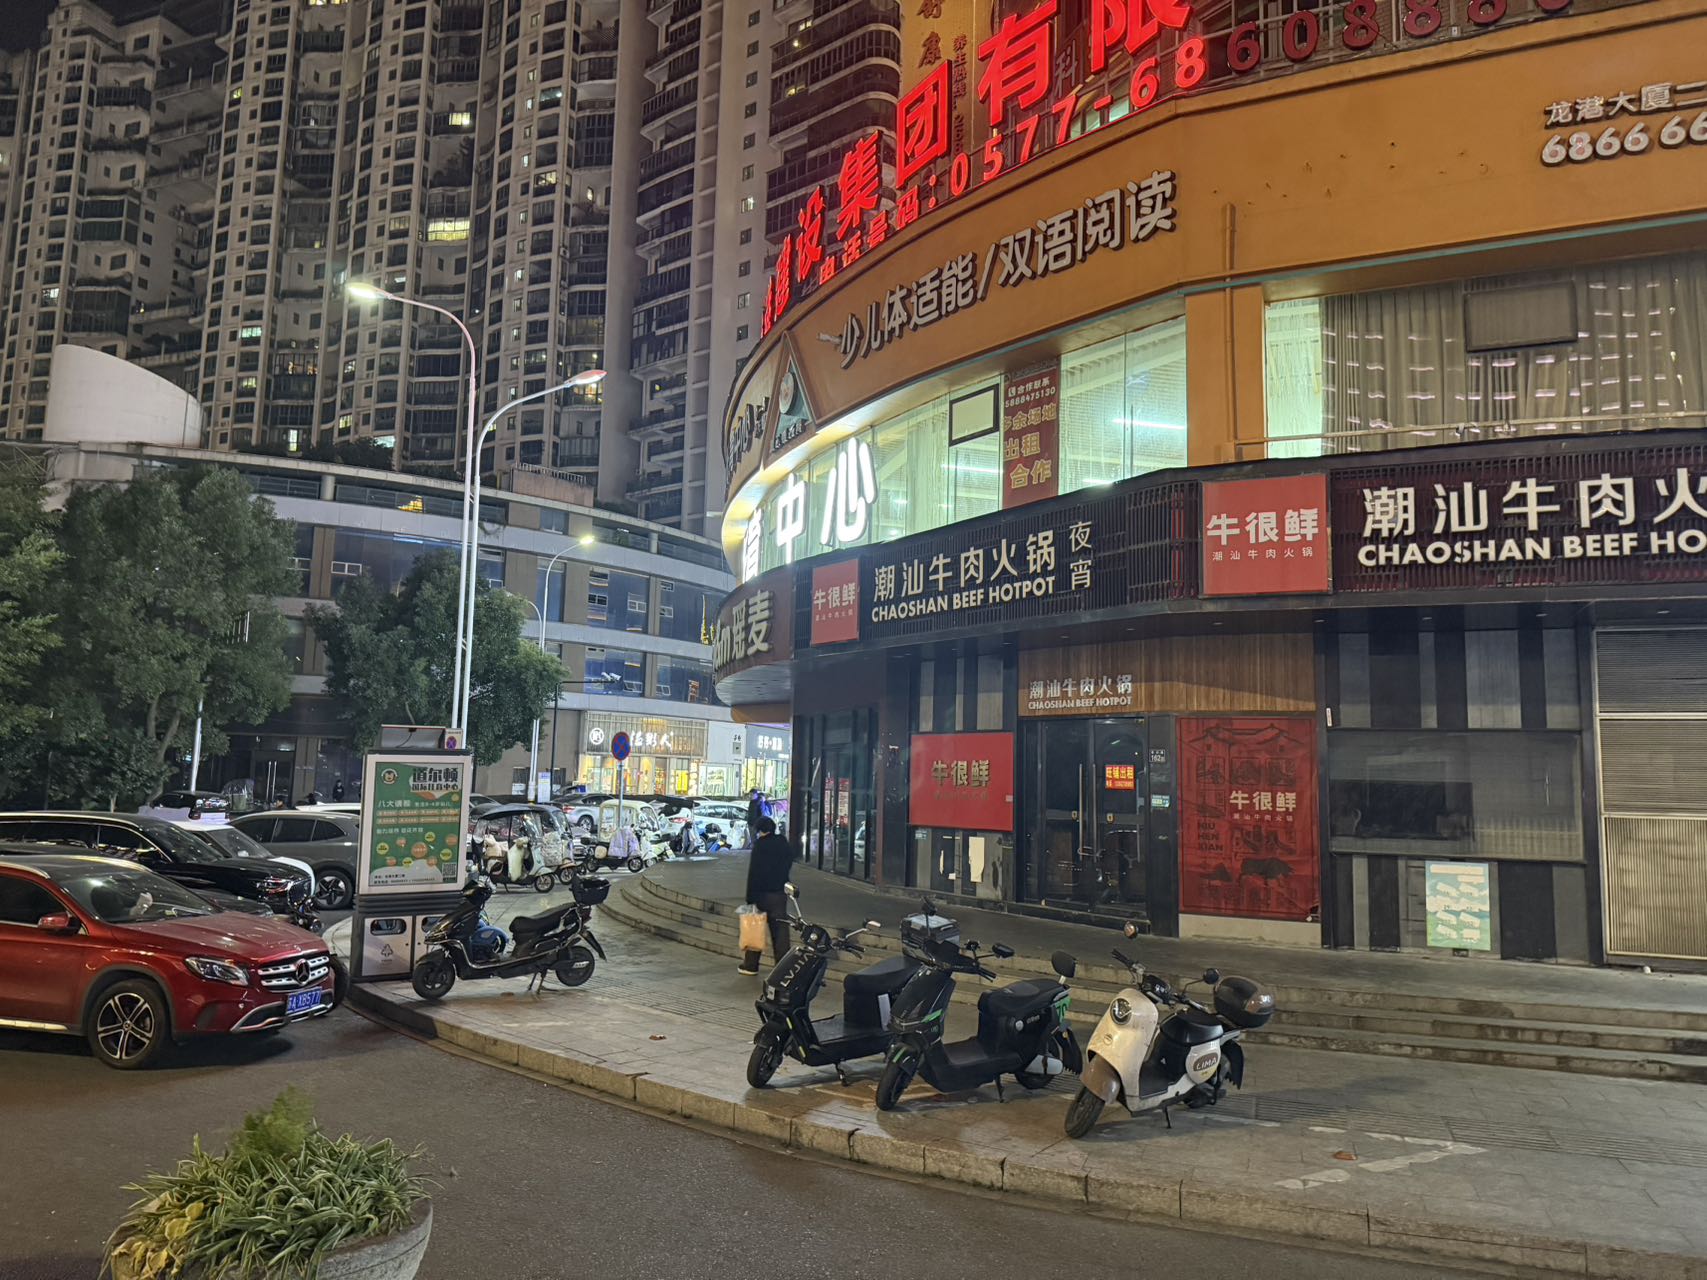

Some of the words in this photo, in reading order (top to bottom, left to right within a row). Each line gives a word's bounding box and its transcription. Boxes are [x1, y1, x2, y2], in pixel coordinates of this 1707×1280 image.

[1542, 122, 1650, 165] 6866
[840, 170, 1175, 369] 少儿体适能/双语阅读
[1003, 402, 1057, 432] 多余场地
[1004, 431, 1041, 461] 出租
[1010, 458, 1052, 489] 合作
[1362, 467, 1707, 538] 潮汕牛肉火
[1206, 507, 1319, 545] 牛很鲜
[1069, 520, 1093, 591] 夜宵
[1212, 546, 1313, 561] 潮汕牛肉火锅
[1357, 537, 1551, 567] CHAOSHAN
[1563, 532, 1640, 559] BEEF
[873, 529, 1056, 602] 潮汕牛肉火锅
[813, 582, 857, 611] 牛很鲜
[872, 595, 948, 623] CHAOSHAN
[952, 588, 985, 611] BEEF
[989, 576, 1056, 604] HOTPOT
[1029, 674, 1133, 699] 潮汕牛肉火锅
[1028, 700, 1075, 710] CHAOSHAN
[1076, 698, 1096, 707] BEEF
[1096, 696, 1133, 707] HOTPOT
[932, 759, 991, 787] 牛很鲜
[1229, 790, 1297, 812] 牛很鲜
[1196, 1057, 1217, 1070] LIMA
